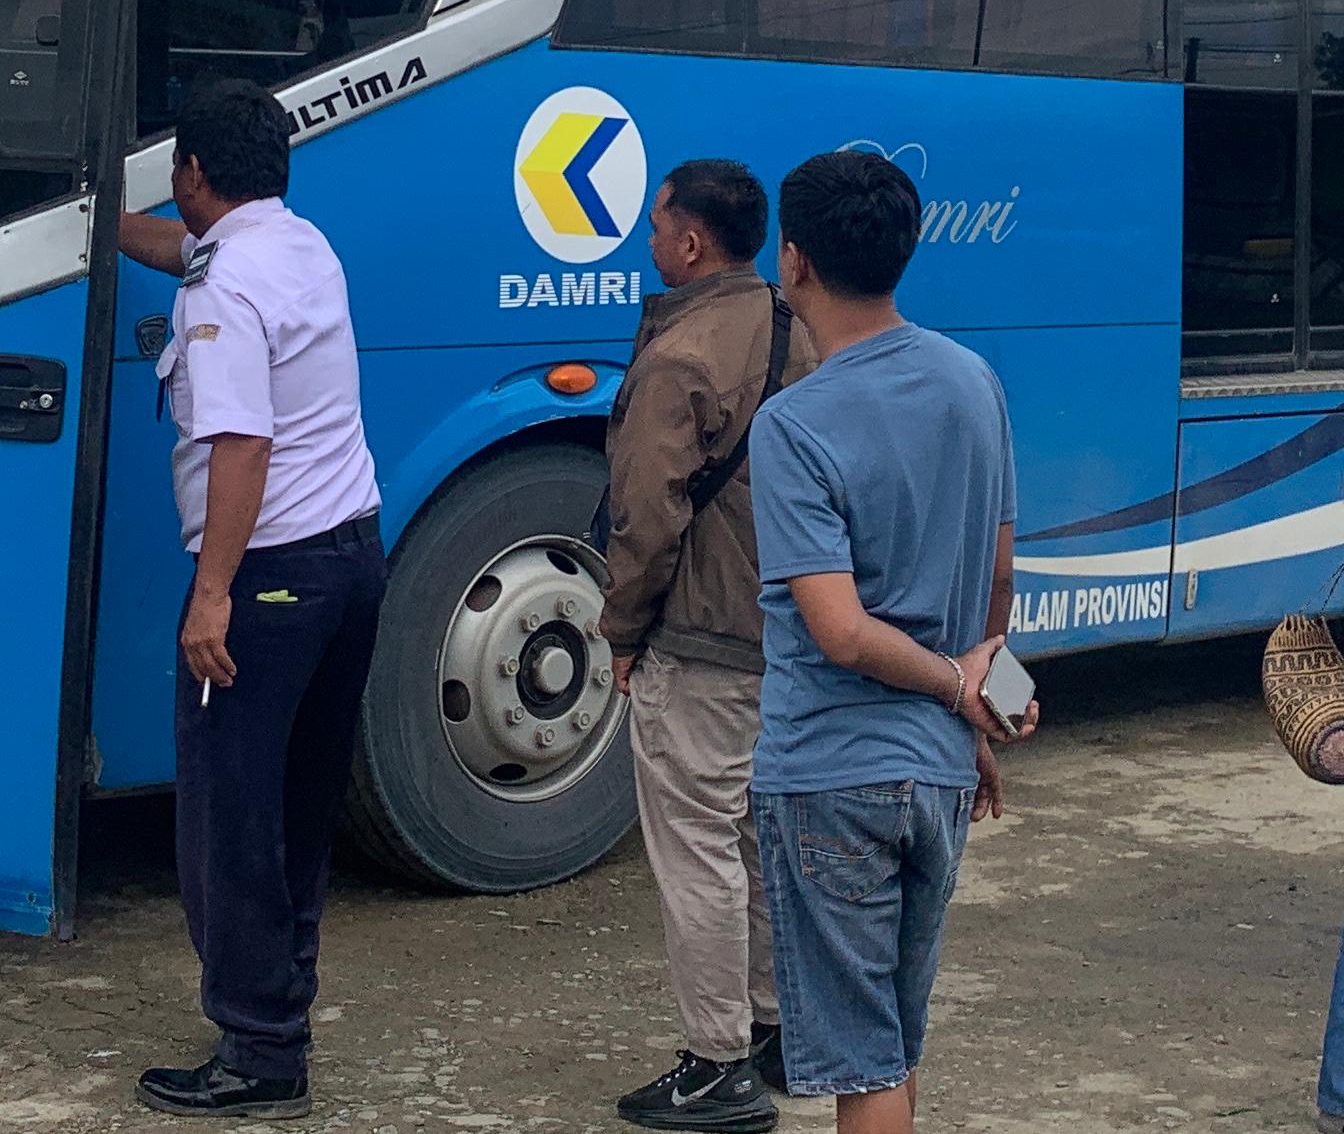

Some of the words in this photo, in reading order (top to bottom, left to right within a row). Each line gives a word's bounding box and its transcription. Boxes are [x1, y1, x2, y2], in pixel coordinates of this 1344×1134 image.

[499, 272, 641, 308] DAMRI
[1008, 590, 1069, 634] ALAM
[1073, 579, 1169, 629] PROVINSI
